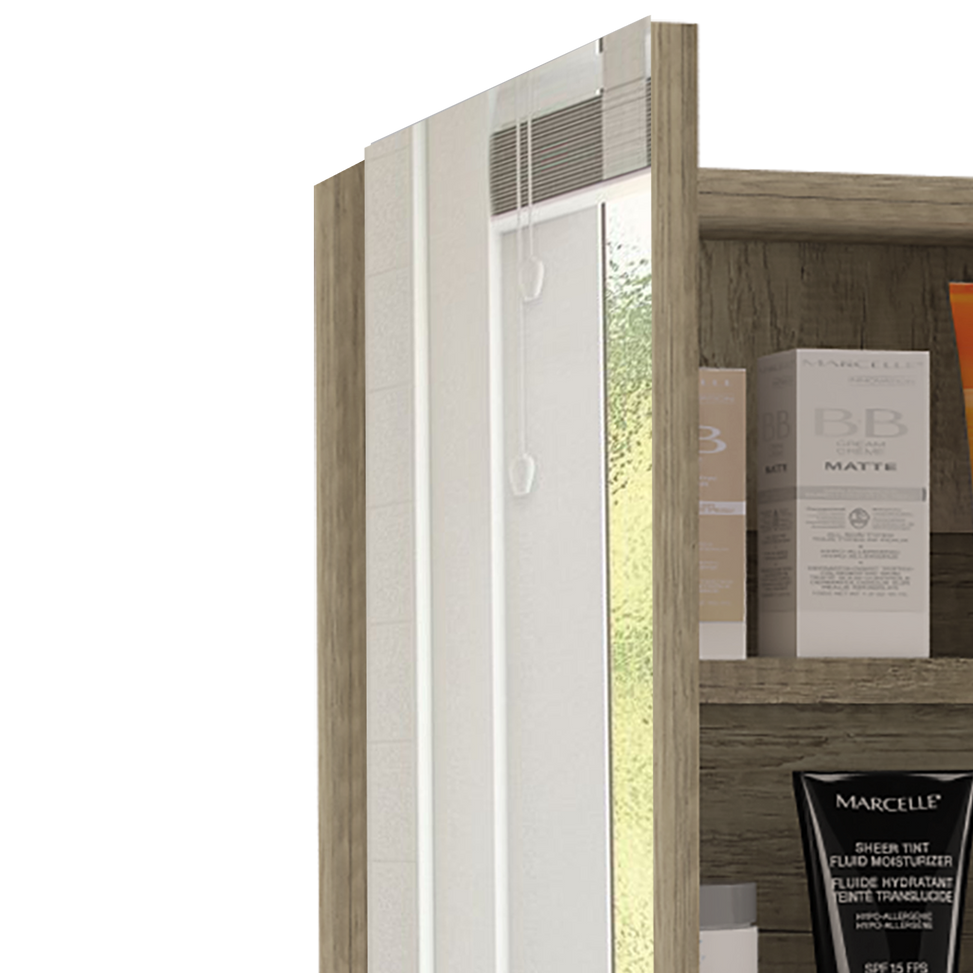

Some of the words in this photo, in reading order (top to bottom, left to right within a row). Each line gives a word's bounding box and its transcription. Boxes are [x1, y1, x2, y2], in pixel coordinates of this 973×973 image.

[824, 461, 897, 471] MATTE
[836, 794, 941, 812] MARCELLE
[855, 842, 899, 854] SHEER
[902, 842, 930, 853] TINT
[830, 855, 868, 867] FLUID
[871, 855, 953, 867] MOISTURIZER
[832, 876, 878, 889] FLUIDE
[882, 876, 953, 888] HYDRATANT
[876, 890, 953, 903] TRANSLUCIDE
[891, 962, 903, 973] 15
[906, 962, 929, 973] FPS
